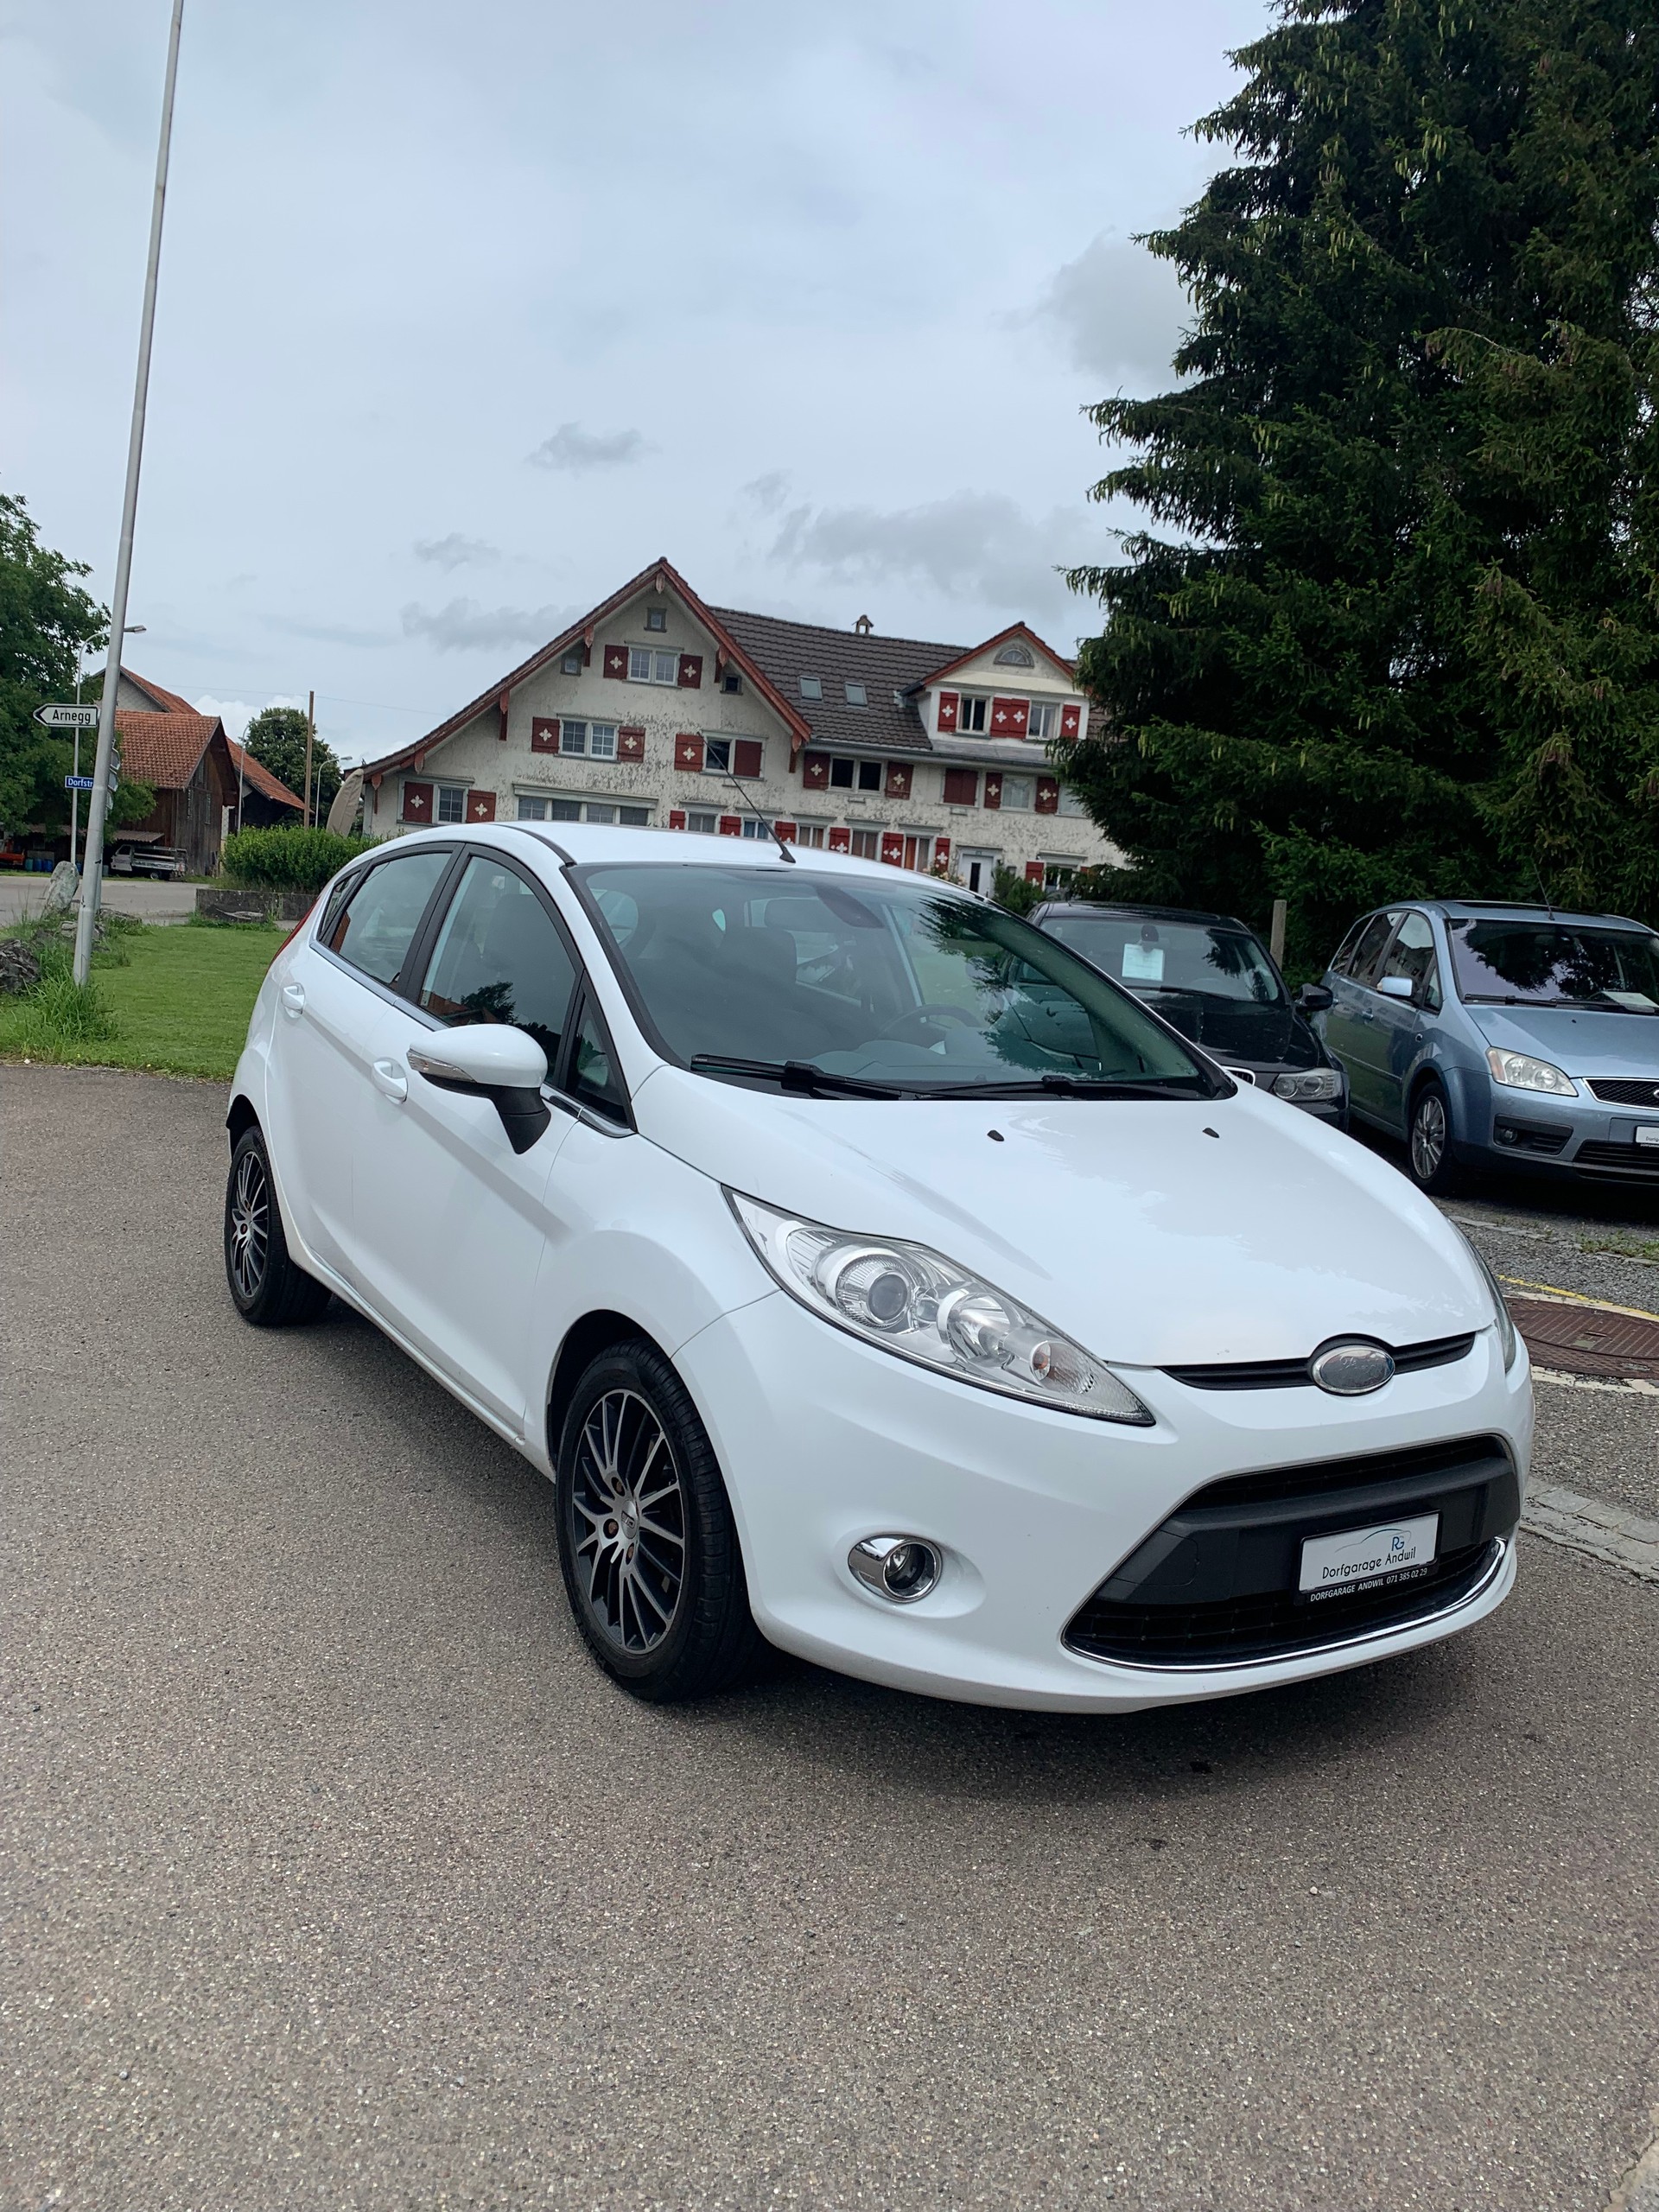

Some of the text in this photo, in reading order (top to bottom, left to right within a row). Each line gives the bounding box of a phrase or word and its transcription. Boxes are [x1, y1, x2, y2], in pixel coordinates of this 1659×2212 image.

[52, 709, 91, 724] Arnegg
[1322, 1546, 1416, 1580] Dorfgarage Andwil
[1310, 1584, 1356, 1602] DORFGARAGE
[1357, 1578, 1384, 1592] ANDWIL
[1386, 1574, 1397, 1585] 071
